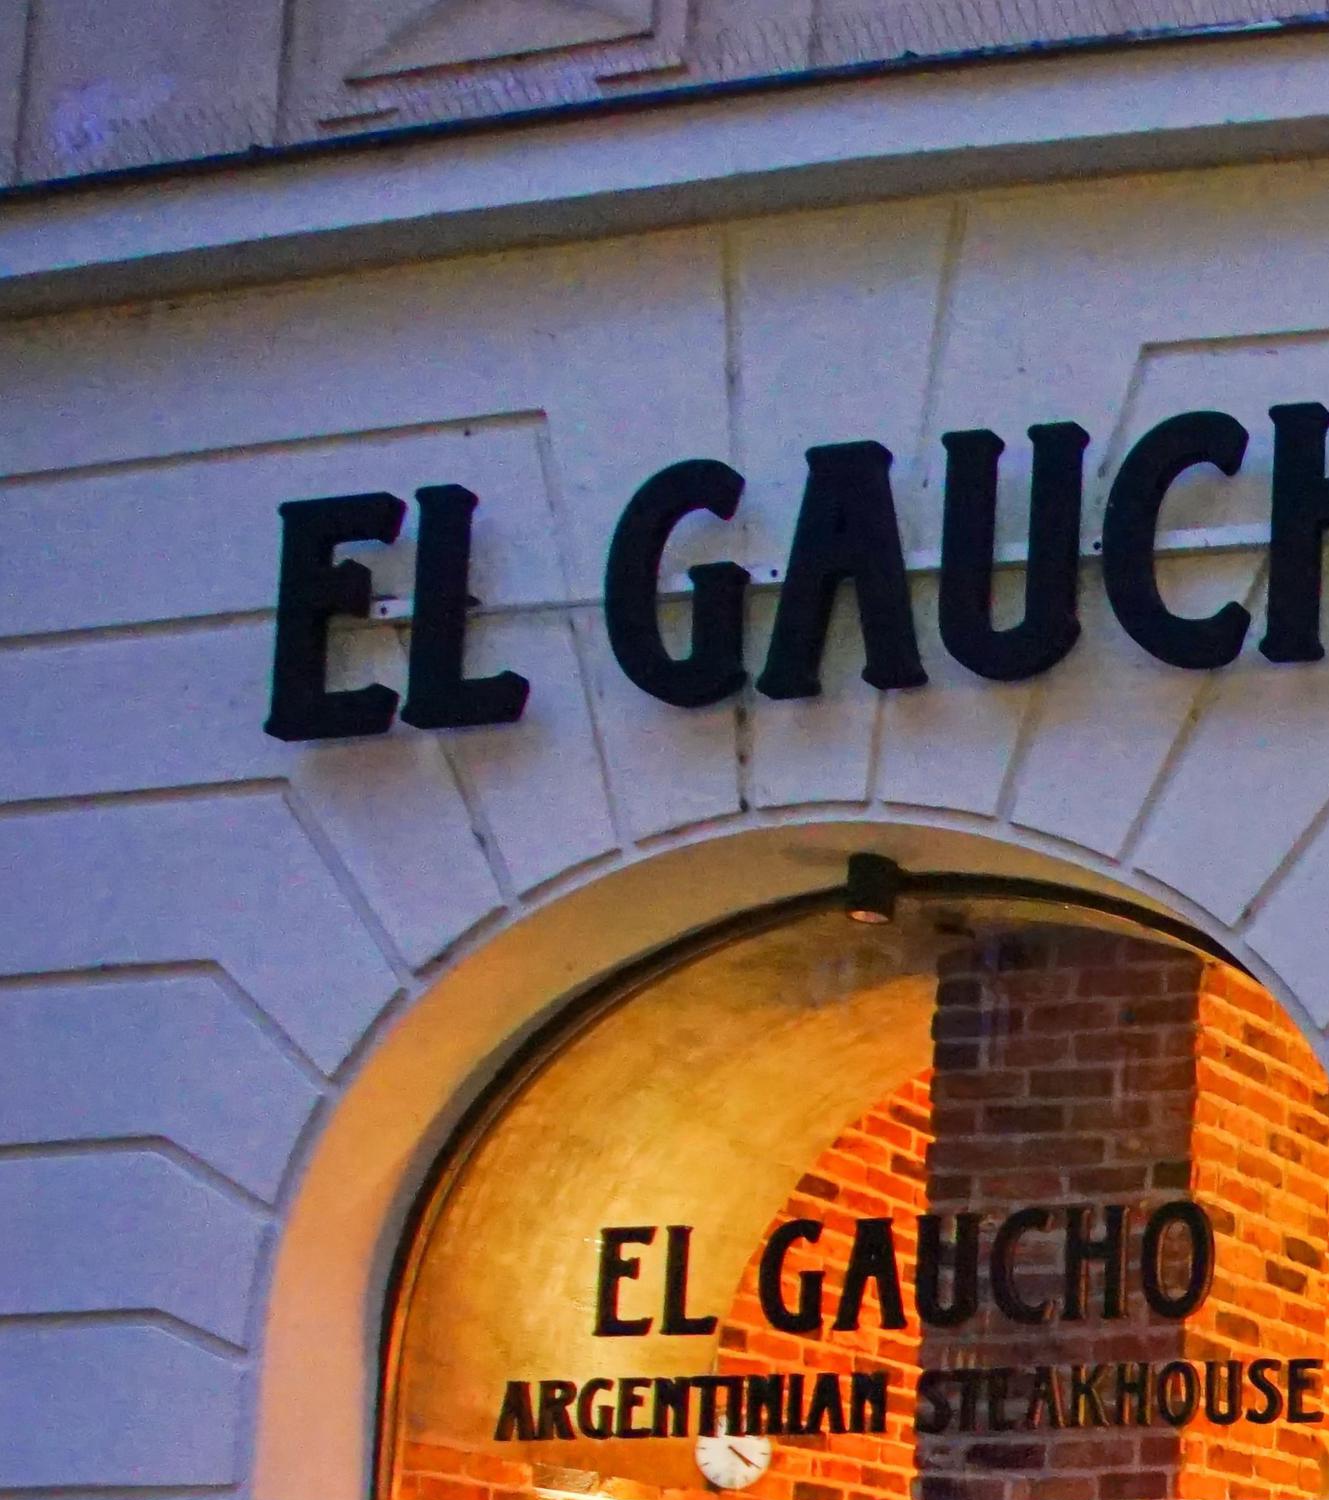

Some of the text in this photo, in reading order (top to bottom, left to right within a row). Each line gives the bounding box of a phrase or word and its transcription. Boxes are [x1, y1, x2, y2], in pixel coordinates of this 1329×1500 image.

[264, 484, 529, 744] EL
[594, 1201, 1216, 1337] EL GAUCHO
[494, 1357, 1325, 1442] ARGENTINIAN STEAKHOUSE
